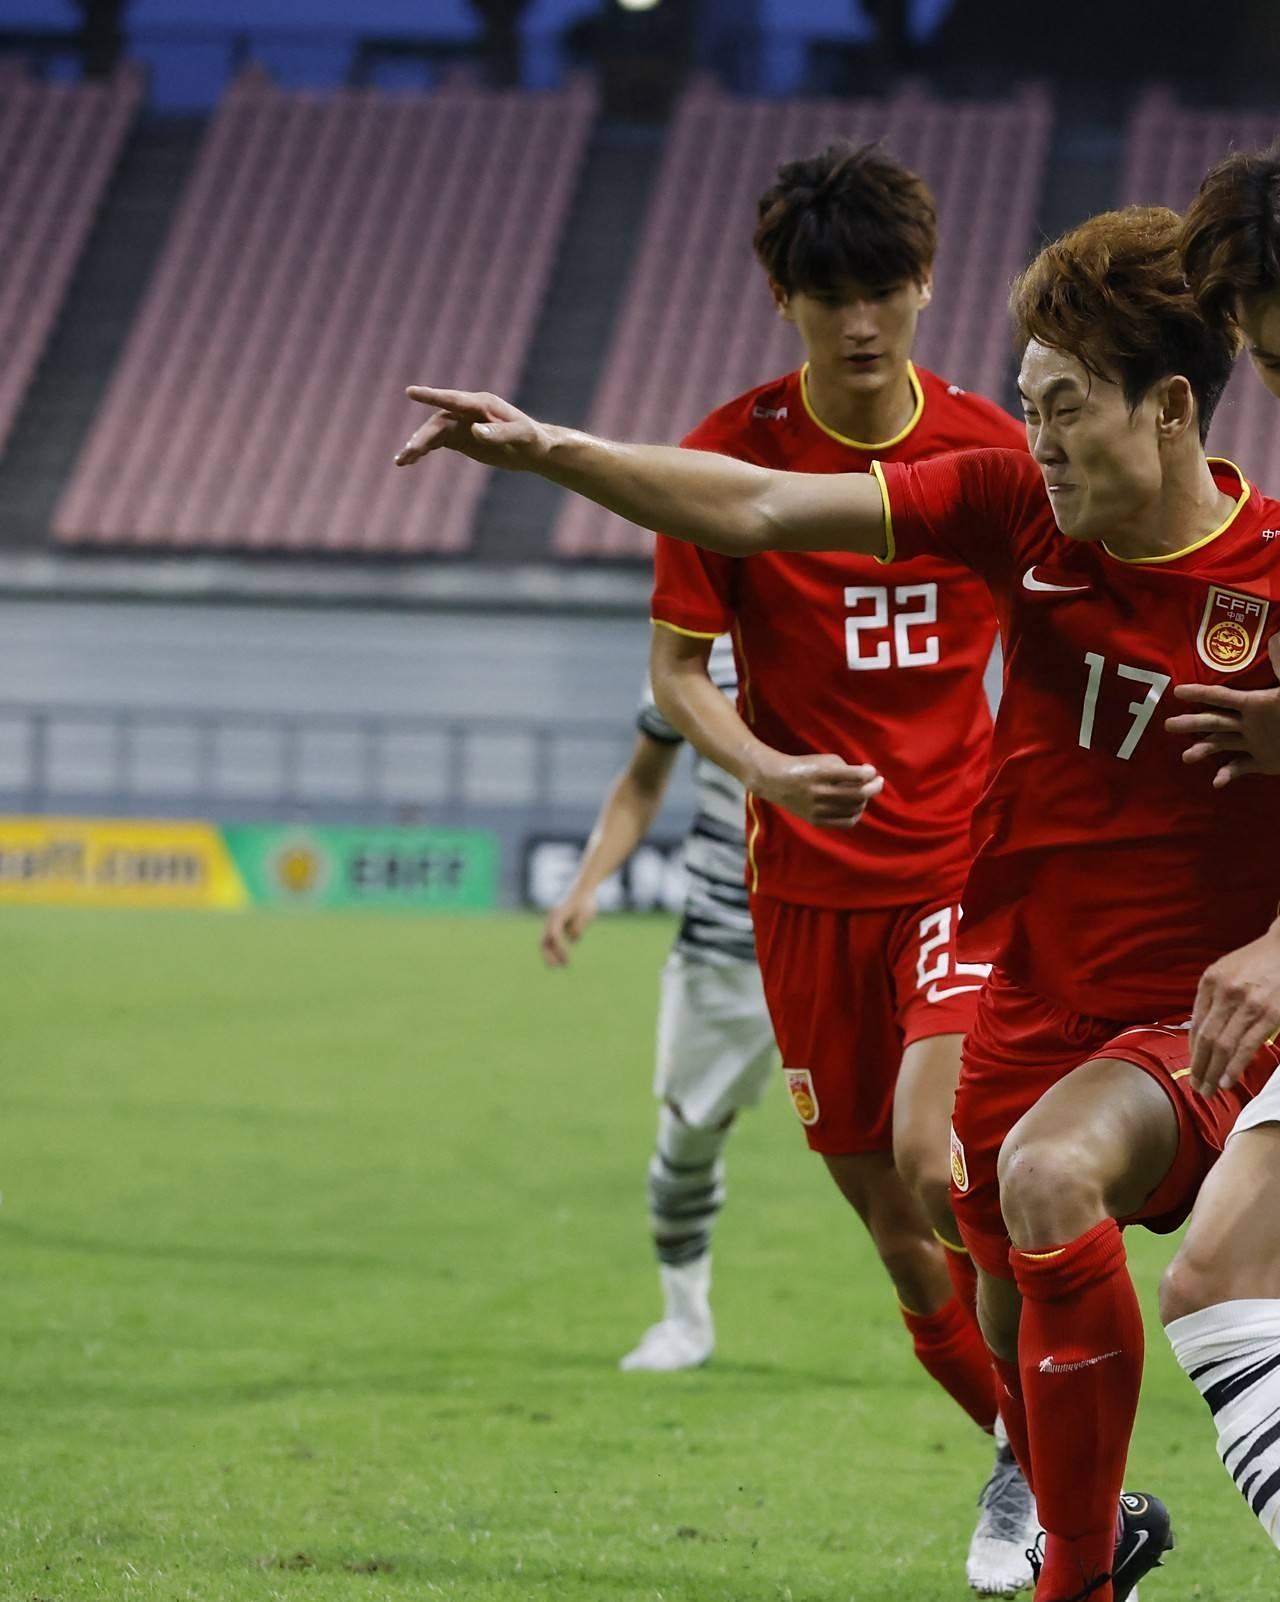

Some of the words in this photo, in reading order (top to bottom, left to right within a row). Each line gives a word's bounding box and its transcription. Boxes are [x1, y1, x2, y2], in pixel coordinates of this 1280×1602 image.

[844, 582, 940, 671] 22
[1216, 594, 1261, 617] CFA
[1227, 611, 1245, 623] 中国
[1079, 651, 1172, 760] 17
